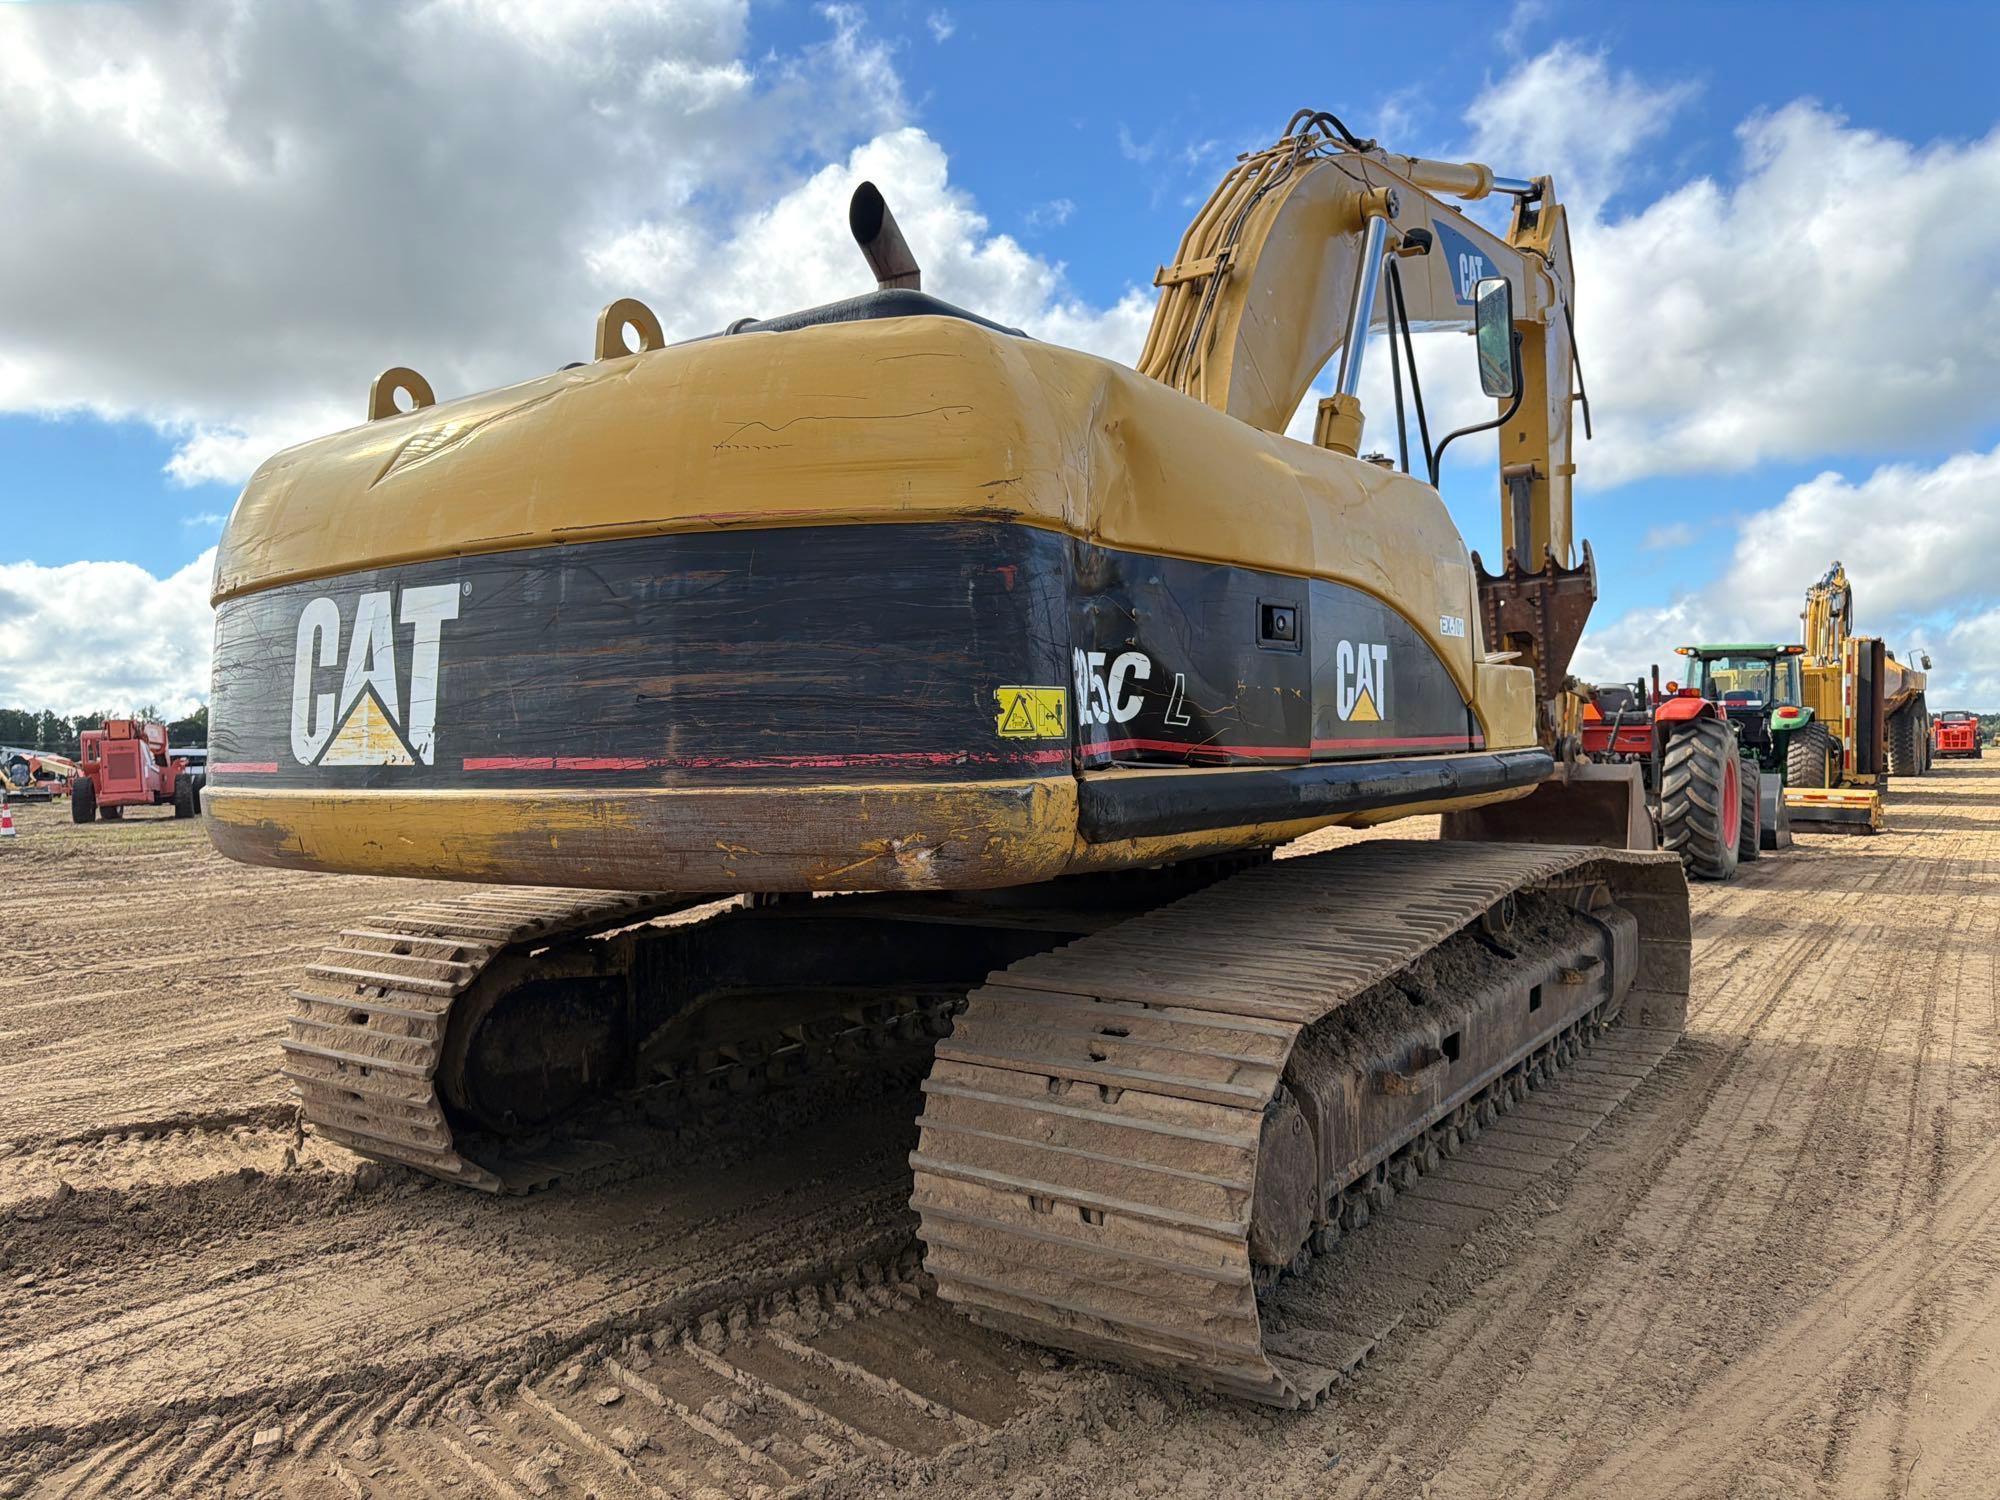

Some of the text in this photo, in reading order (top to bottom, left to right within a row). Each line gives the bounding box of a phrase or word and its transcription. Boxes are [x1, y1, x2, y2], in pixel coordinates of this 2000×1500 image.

[1459, 253, 1483, 300] CAT
[290, 583, 461, 767] CAT
[1164, 673, 1191, 727] L
[1336, 639, 1388, 721] CAT
